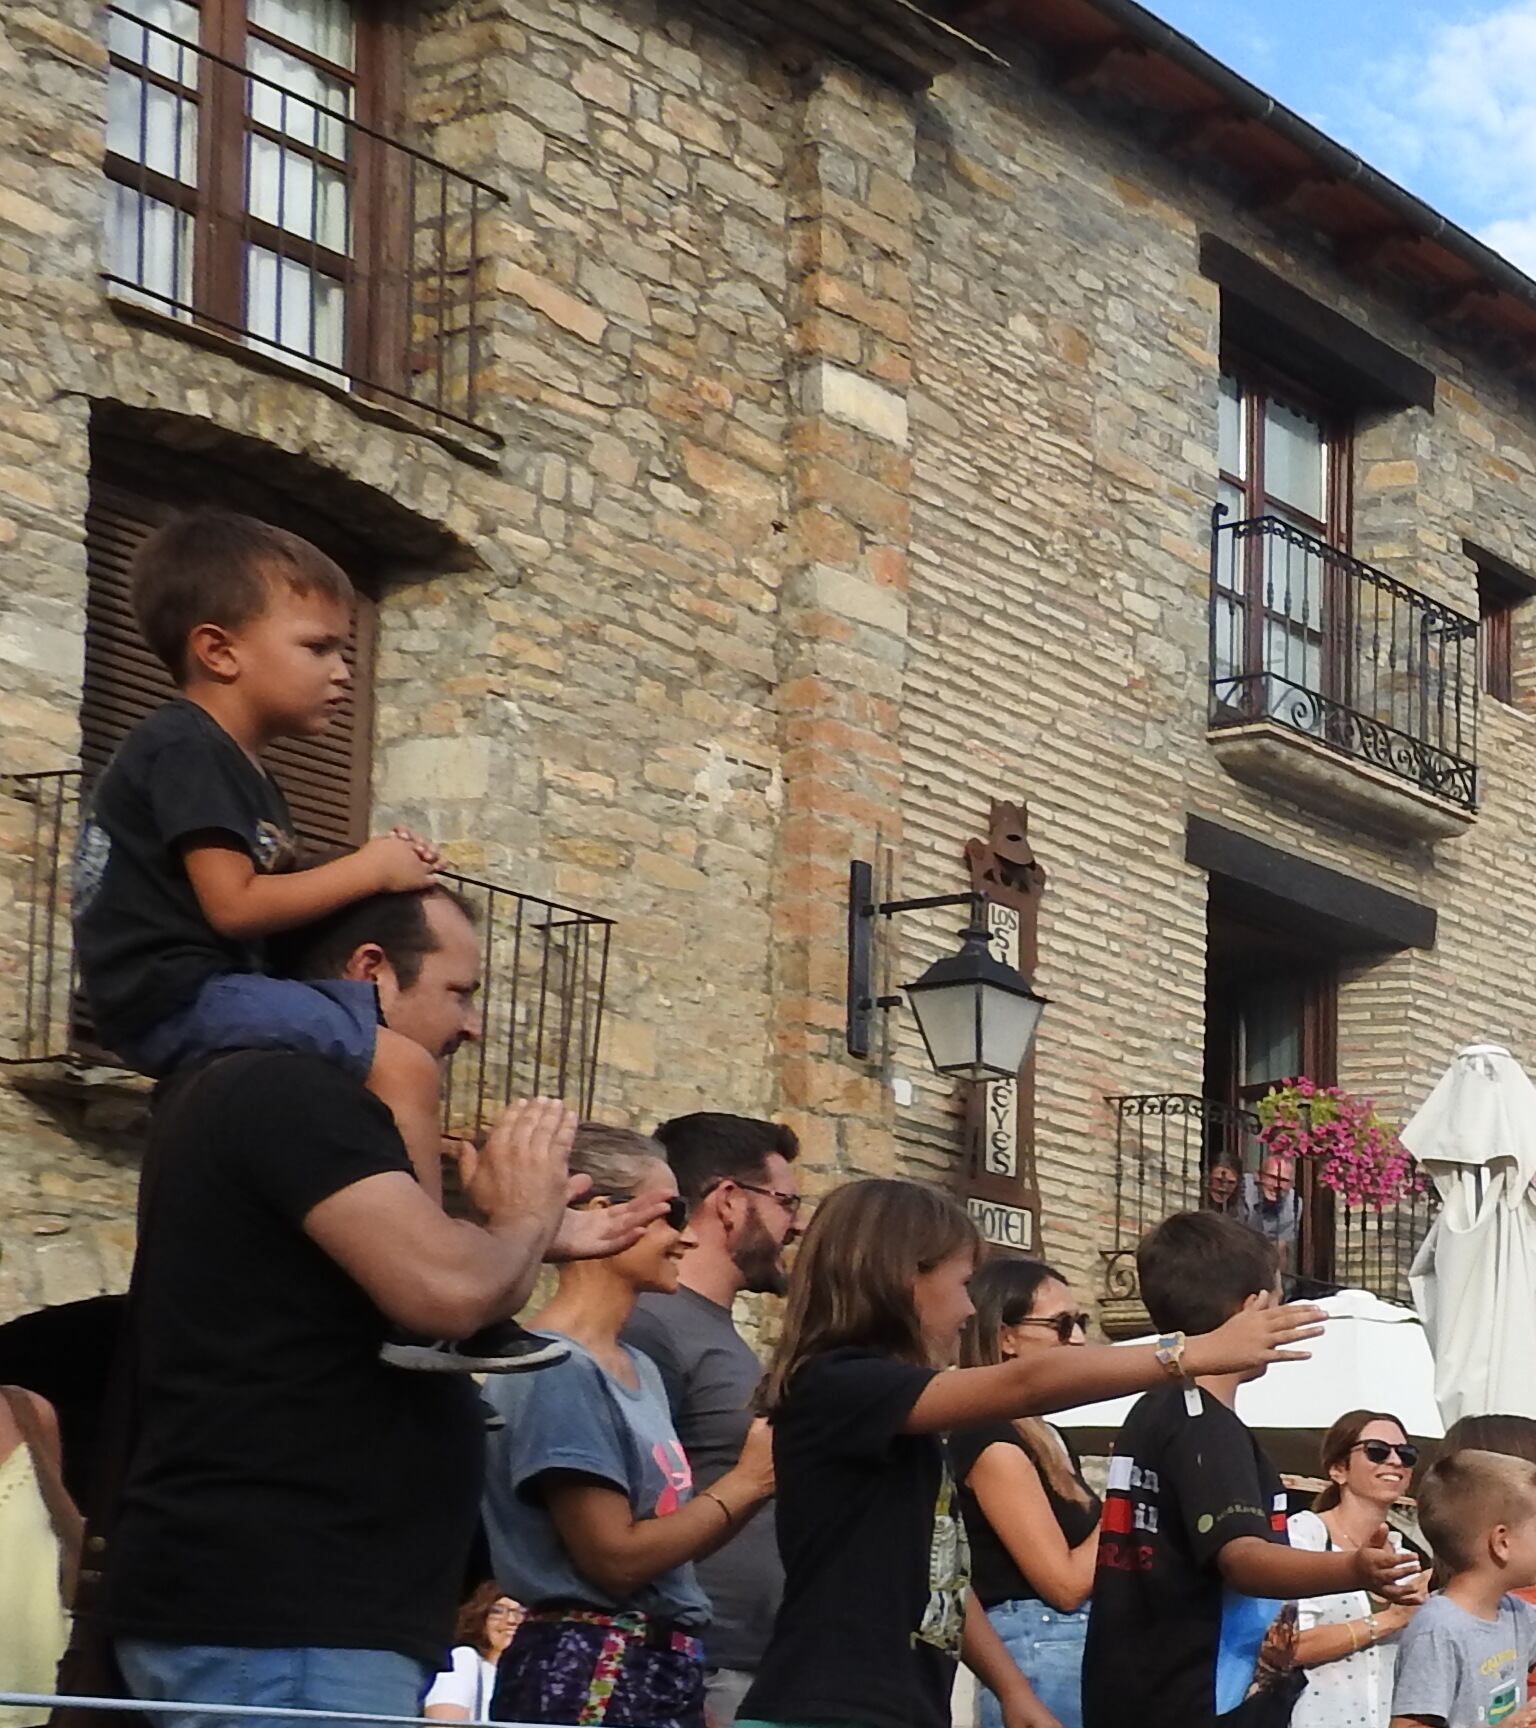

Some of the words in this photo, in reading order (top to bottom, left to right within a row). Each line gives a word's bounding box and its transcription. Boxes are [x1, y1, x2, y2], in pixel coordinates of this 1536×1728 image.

[991, 905, 1018, 931] LOS
[991, 1083, 1013, 1174] EYES
[970, 1202, 1030, 1247] HOTEL
